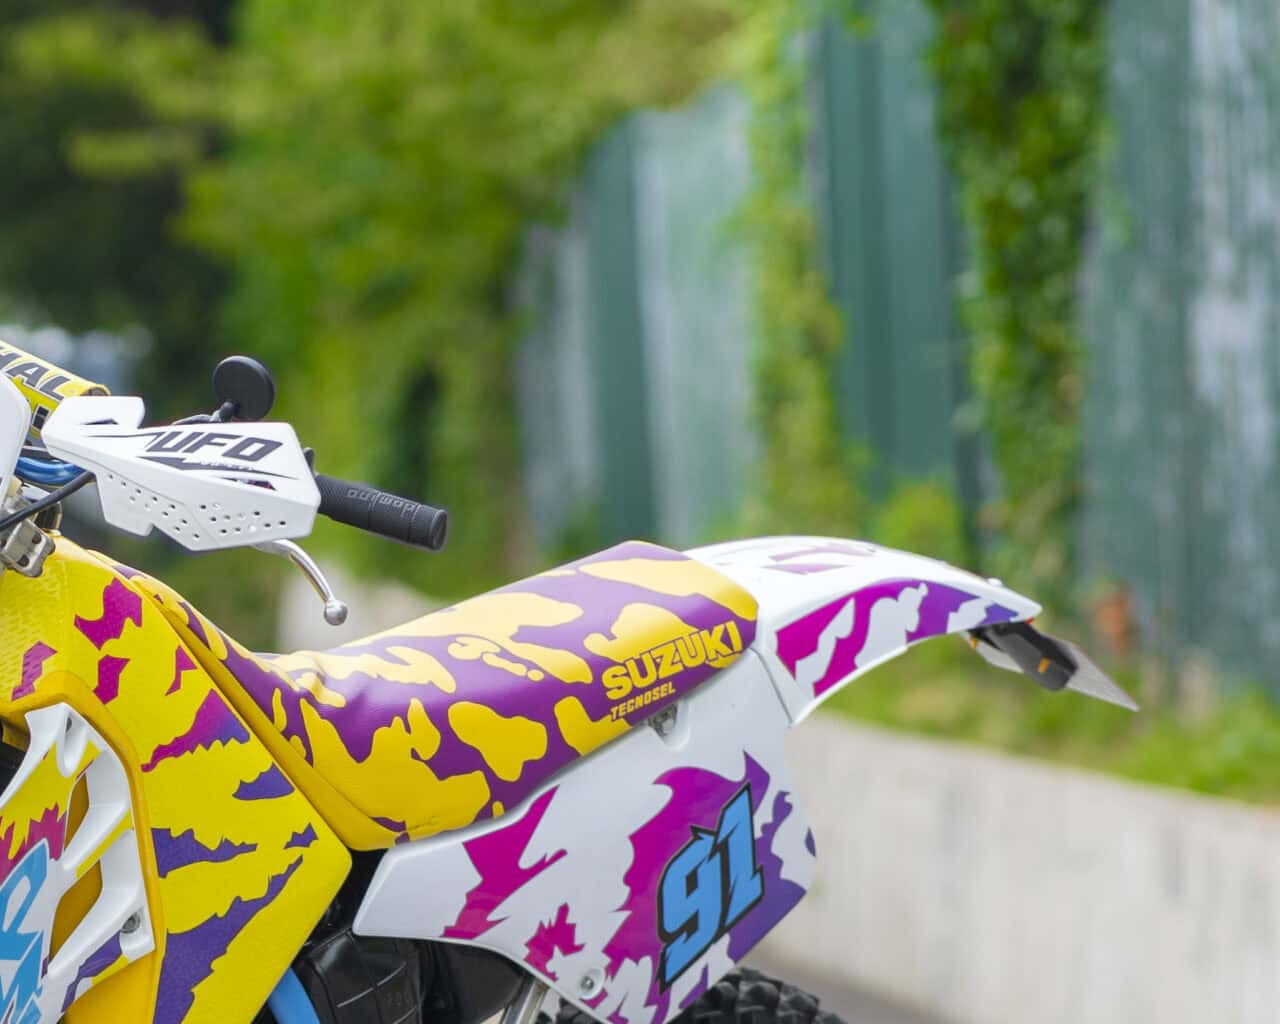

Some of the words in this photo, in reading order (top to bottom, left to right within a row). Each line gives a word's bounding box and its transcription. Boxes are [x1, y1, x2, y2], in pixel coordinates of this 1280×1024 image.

[146, 431, 283, 462] UFO
[602, 620, 743, 700] SUZUKI
[610, 682, 676, 722] TECNOSEL
[656, 782, 765, 995] 91
